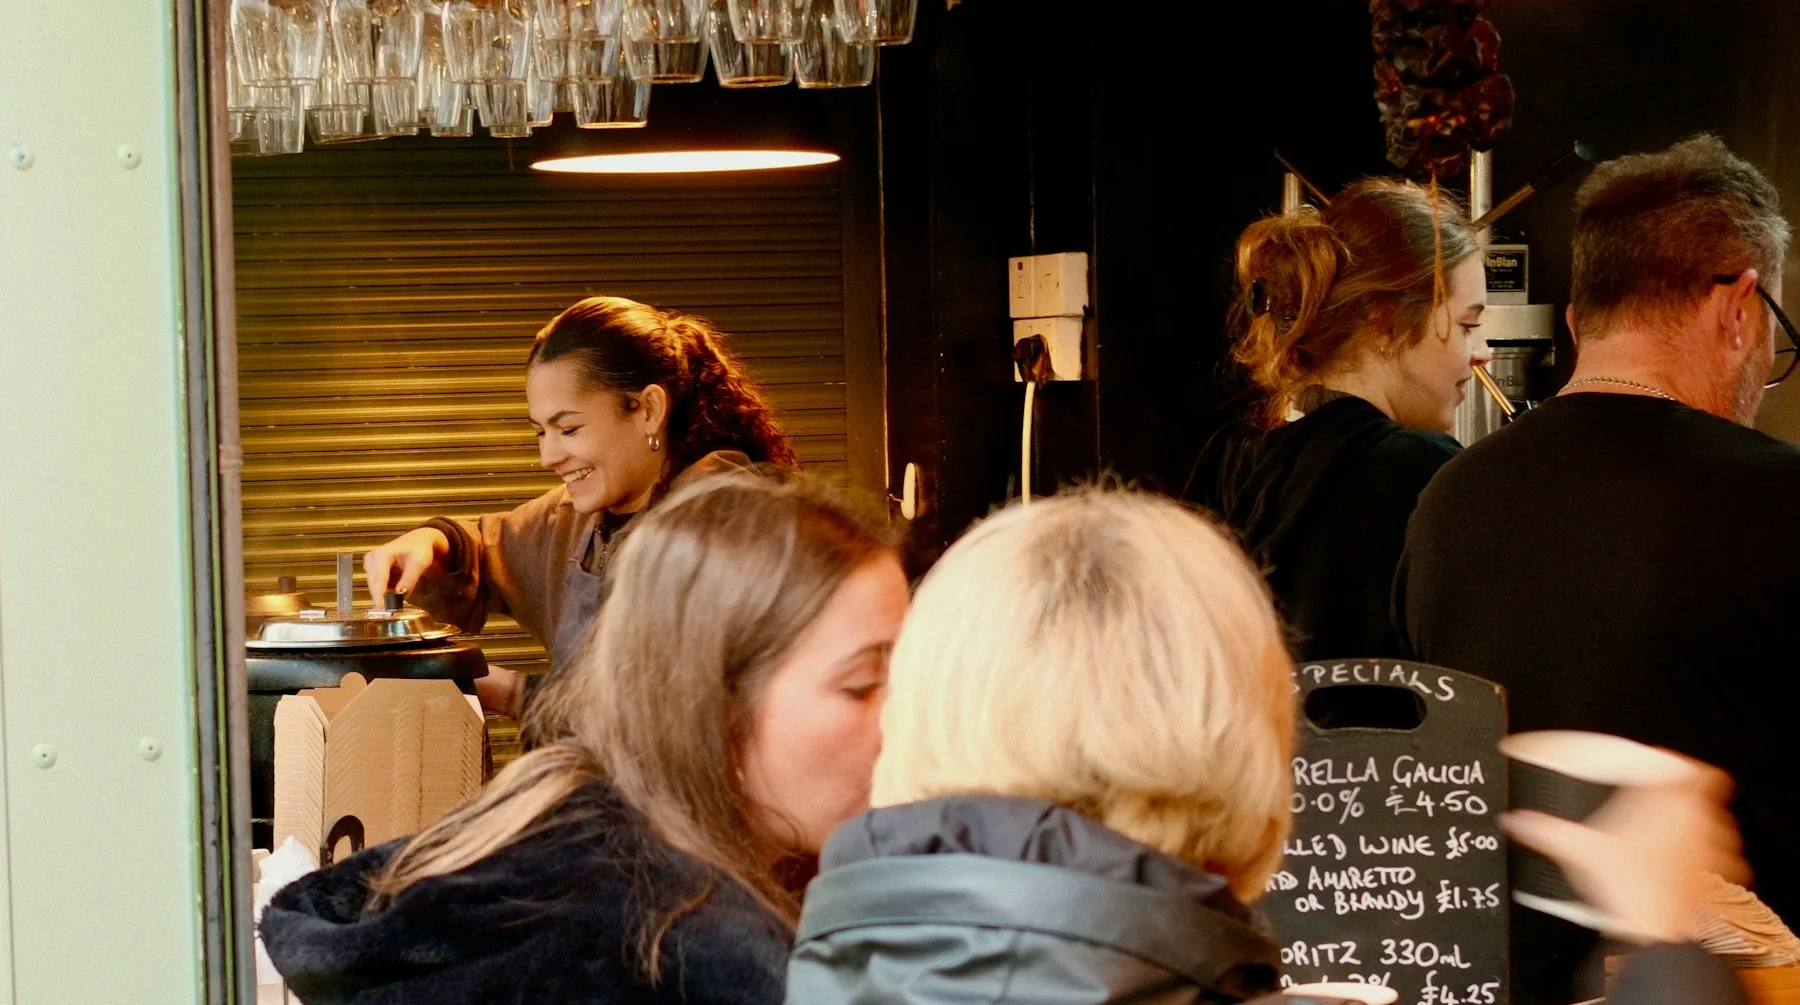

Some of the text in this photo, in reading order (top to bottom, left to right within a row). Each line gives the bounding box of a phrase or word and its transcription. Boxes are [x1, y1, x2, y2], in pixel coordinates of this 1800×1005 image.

[1392, 755, 1485, 788] GALICIA
[1384, 785, 1488, 817] £4.50
[1359, 834, 1435, 856] WINE
[1445, 826, 1498, 859] £5.00
[1307, 865, 1416, 891] AMARETTO
[1295, 879, 1500, 920] OR BRANDY £1.75
[1416, 970, 1500, 1005] £4.25
